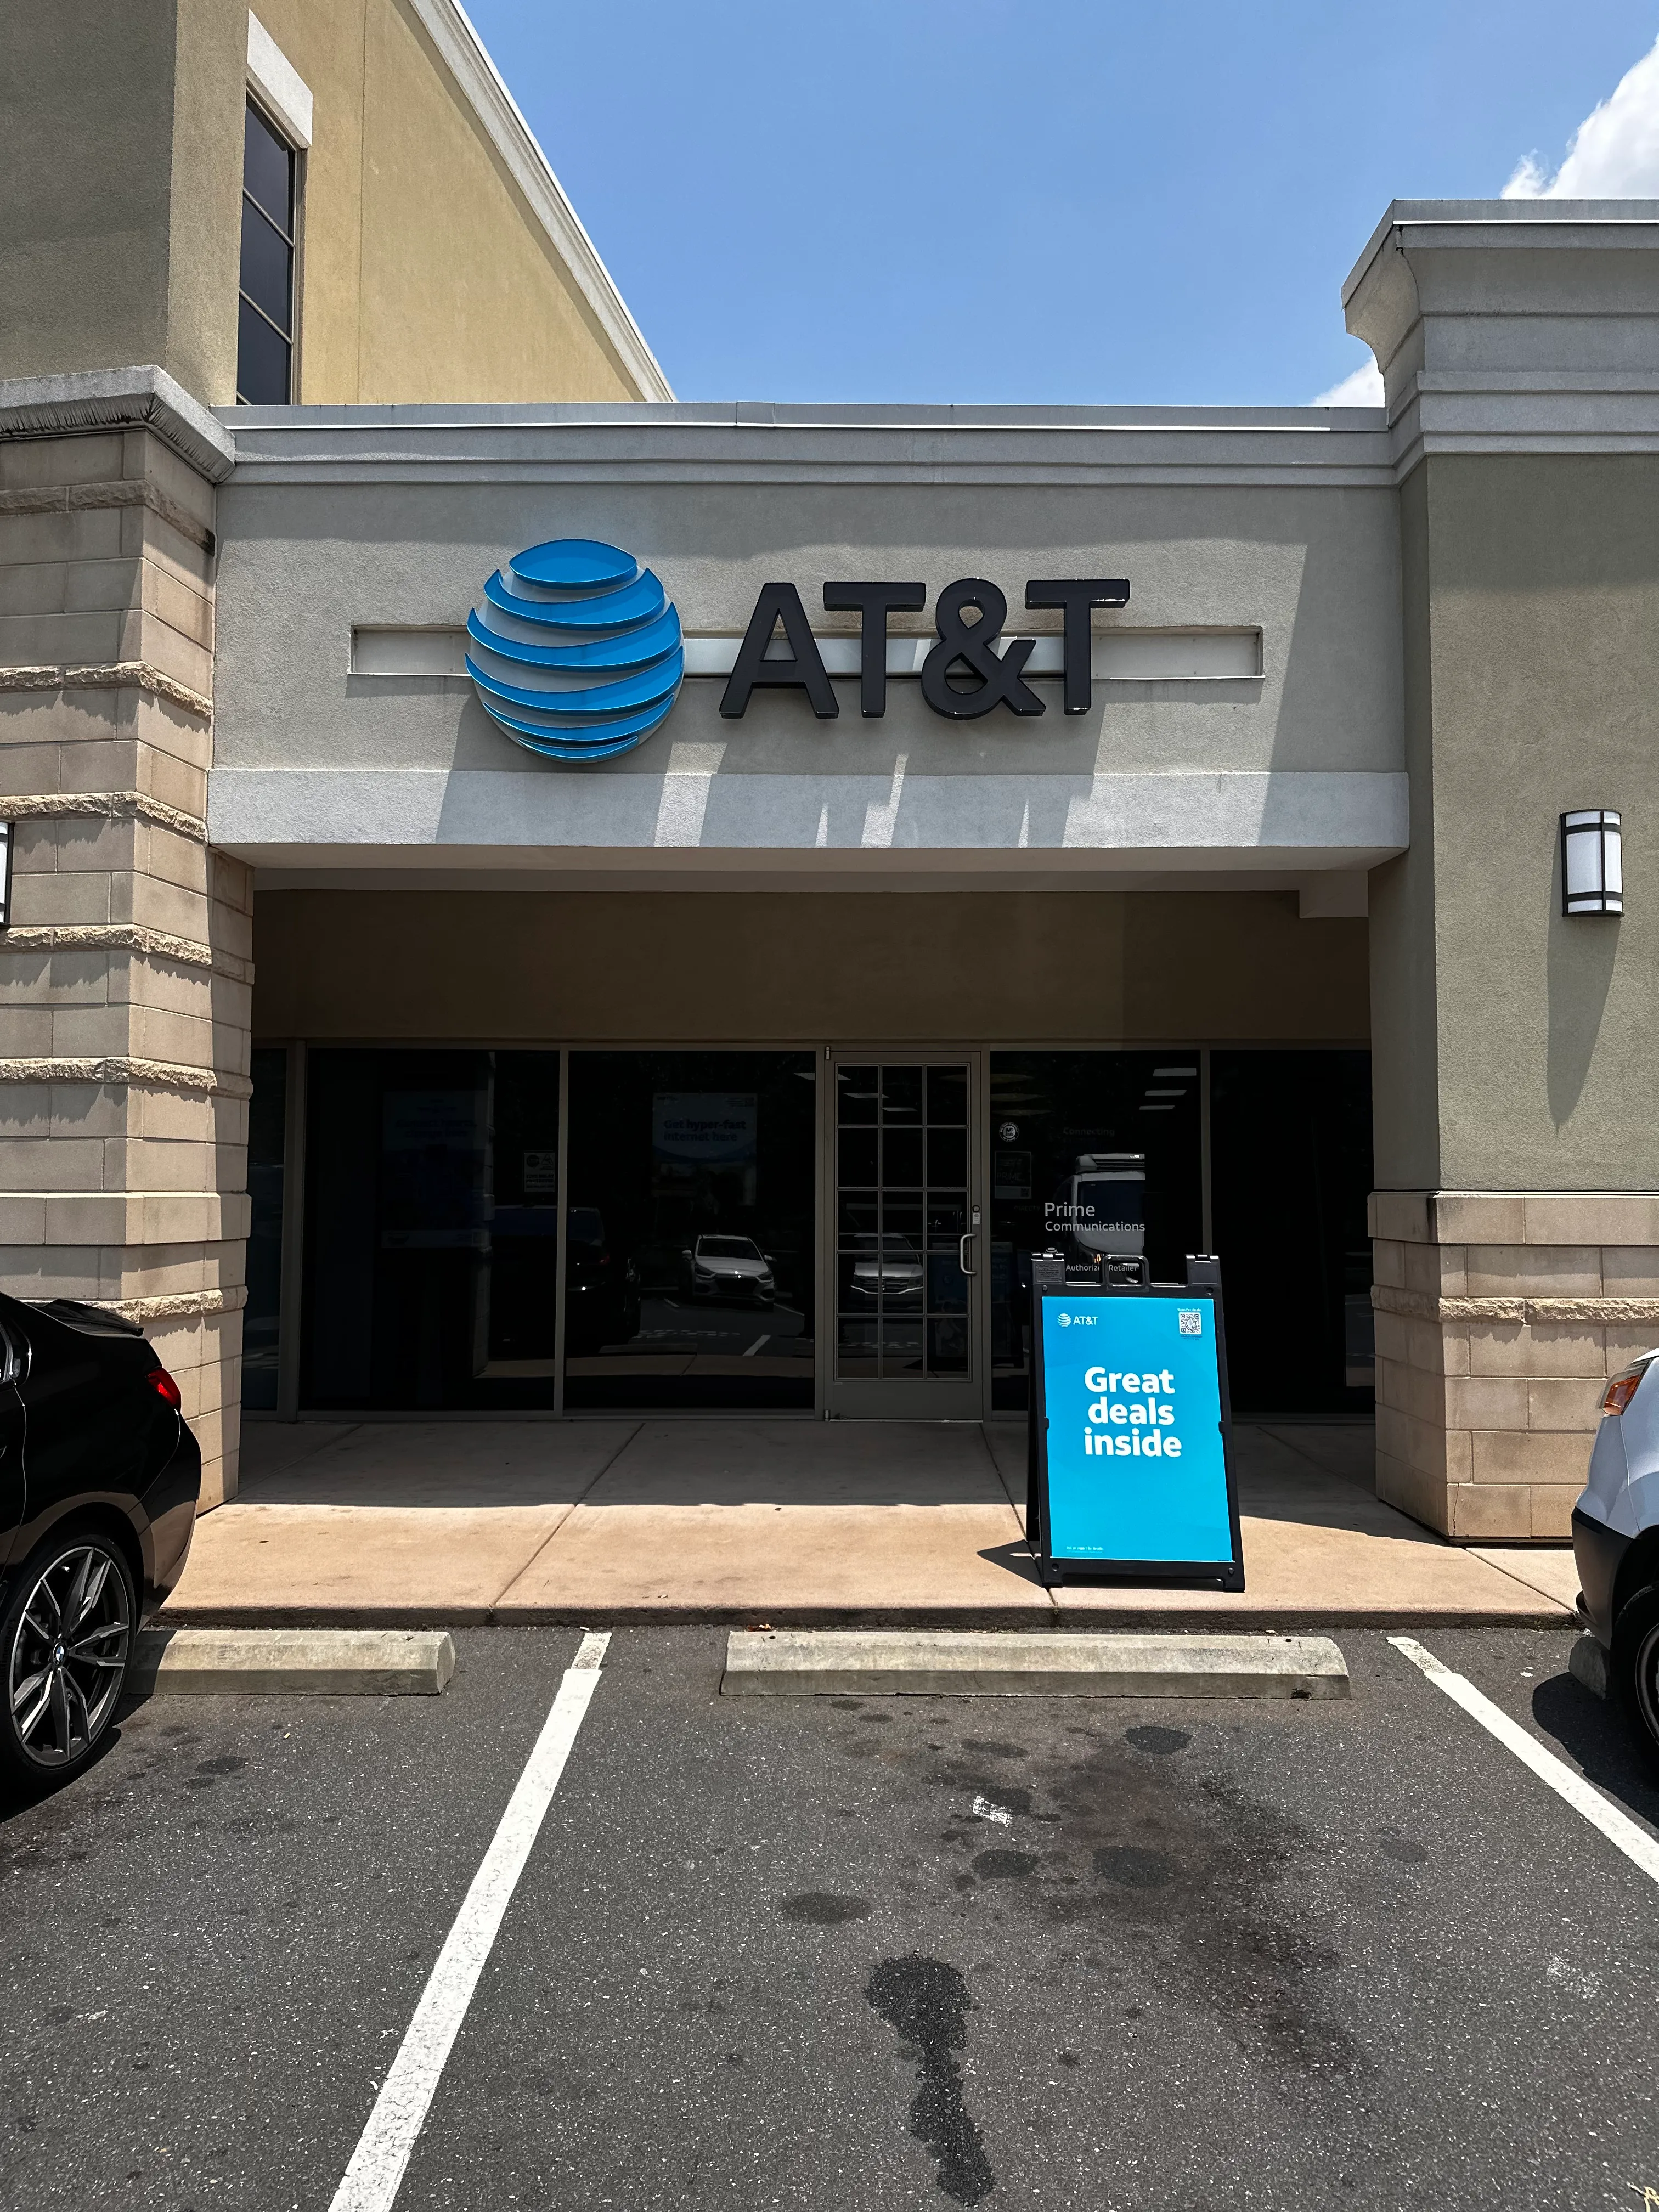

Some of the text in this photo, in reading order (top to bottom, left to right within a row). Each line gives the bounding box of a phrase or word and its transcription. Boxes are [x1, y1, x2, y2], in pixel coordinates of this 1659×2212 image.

[719, 578, 1130, 720] AT&T
[664, 1119, 746, 1131] Get hyper-fast
[713, 1131, 737, 1141] here
[1045, 1202, 1096, 1216] Prime
[1045, 1221, 1145, 1231] Communications
[1073, 1316, 1099, 1325] AT&T
[1084, 1366, 1176, 1394] Great
[1088, 1396, 1175, 1425] deals
[1084, 1427, 1182, 1458] inside
